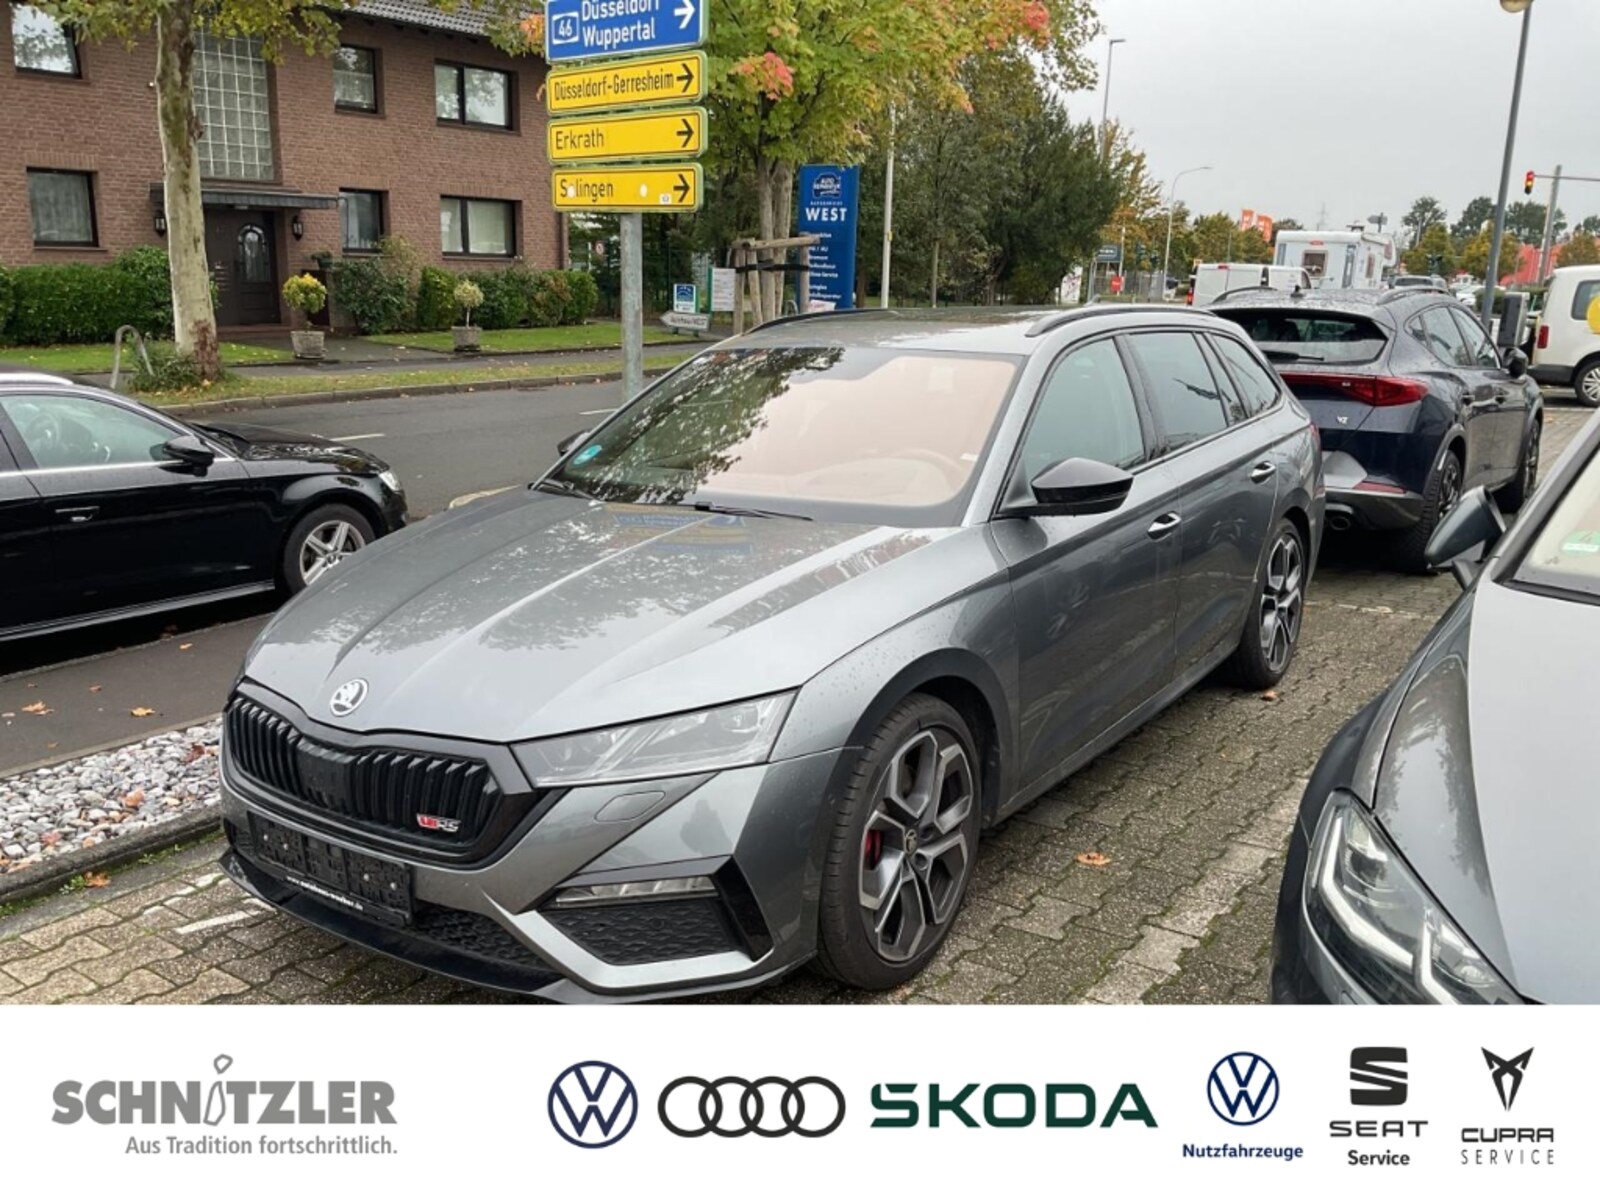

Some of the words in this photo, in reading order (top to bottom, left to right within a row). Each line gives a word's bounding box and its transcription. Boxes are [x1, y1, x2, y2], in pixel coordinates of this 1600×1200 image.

[558, 19, 573, 38] 46
[582, 17, 656, 50] Wuppertal
[554, 69, 674, 101] Düsseldorf-Gerresheim
[555, 127, 604, 150] Erkrath
[560, 178, 613, 203] Slingen
[805, 207, 847, 222] WEST
